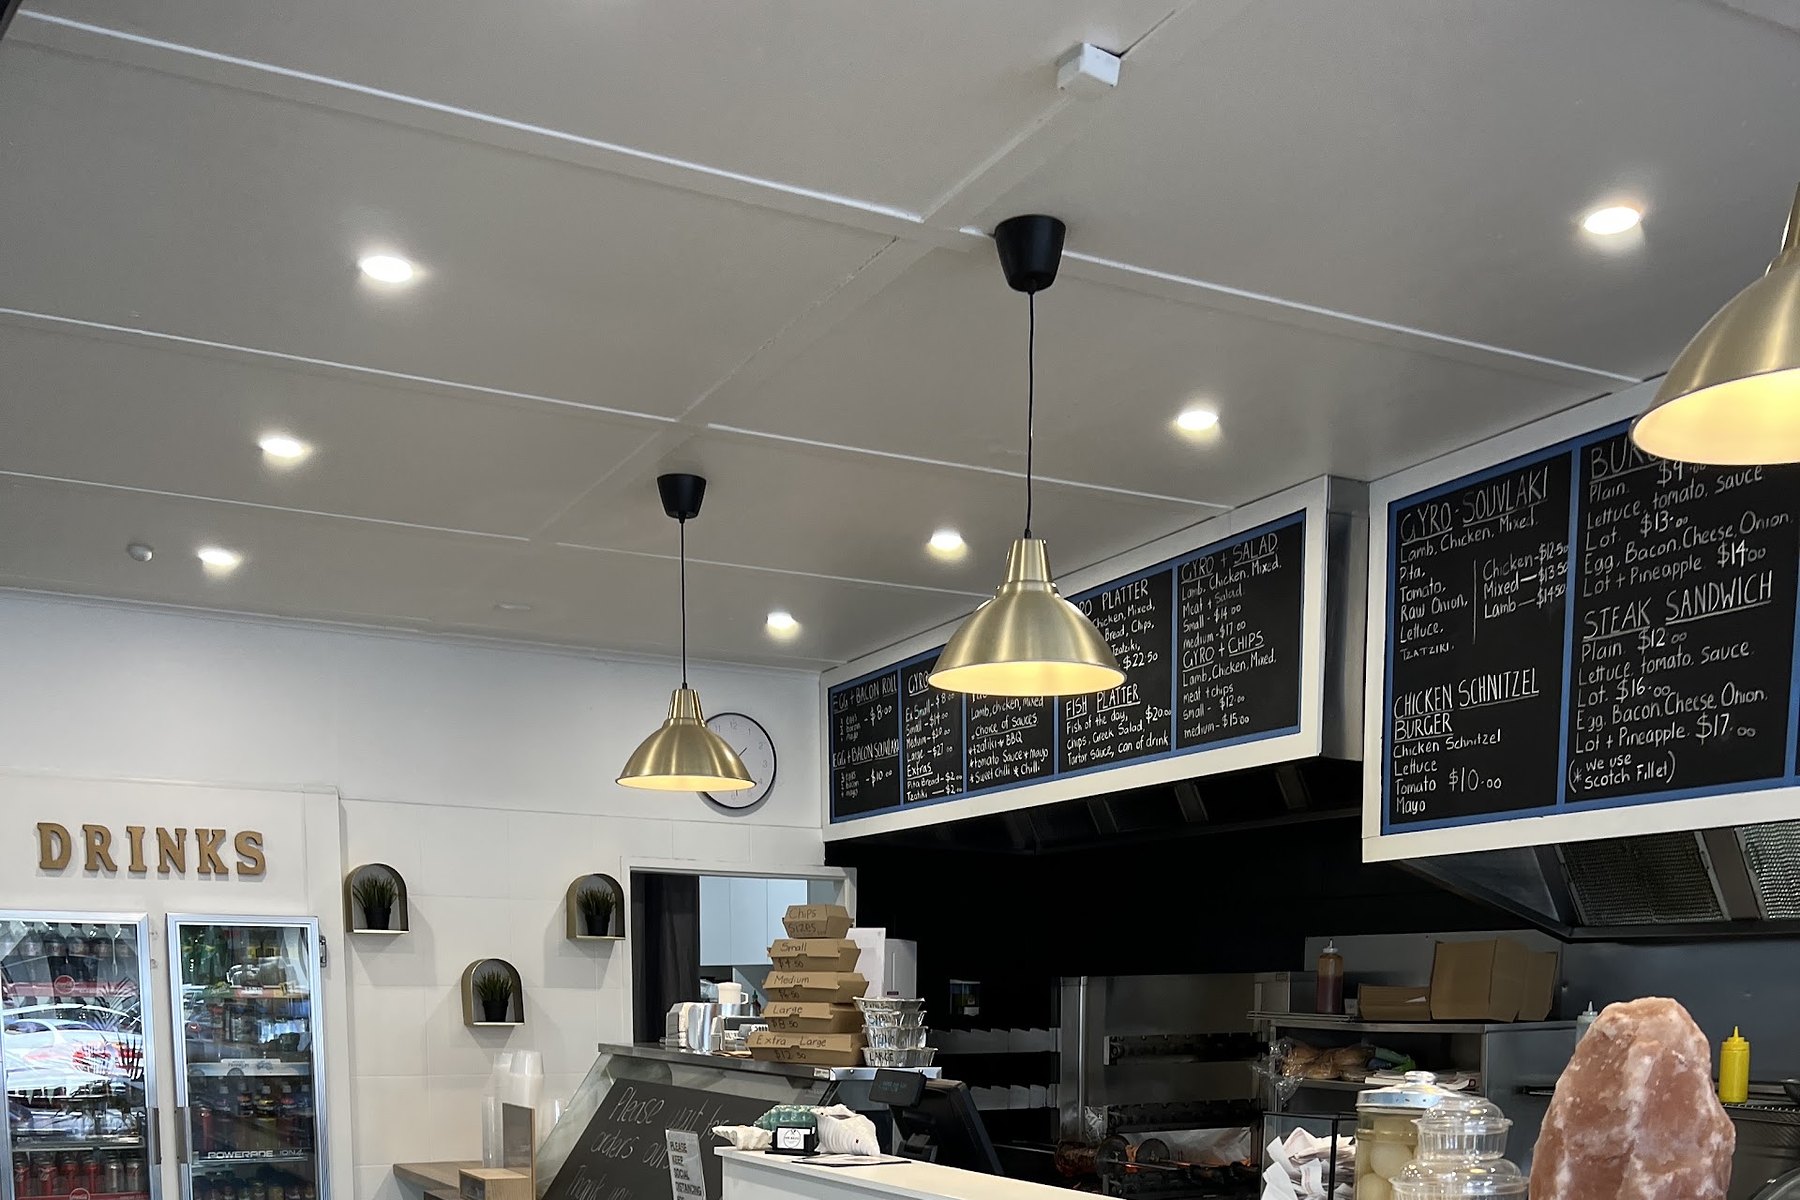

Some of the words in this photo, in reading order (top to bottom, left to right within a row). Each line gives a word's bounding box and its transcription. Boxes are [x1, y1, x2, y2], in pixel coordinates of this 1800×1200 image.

[1462, 466, 1548, 524] SOUVLAKI
[1182, 556, 1214, 582] GYRO
[1102, 579, 1149, 612] PLATTER
[1583, 575, 1610, 598] Lot
[1401, 603, 1425, 623] Raw
[1583, 597, 1650, 639] STEAK
[1666, 576, 1773, 622] SANDWICH
[1182, 646, 1214, 670] GYRO
[1228, 630, 1264, 653] CHIPS
[1066, 695, 1087, 718] FISH
[1097, 683, 1140, 712] PLATTER
[1394, 683, 1453, 719] CHICKEN
[1458, 667, 1540, 708] SCHNITZEL
[1001, 715, 1009, 729] of
[1066, 718, 1082, 735] Fish
[1084, 715, 1092, 729] of
[1095, 712, 1107, 727] the
[1394, 712, 1453, 742] BURGER
[1006, 731, 1022, 746] BBQ
[1092, 729, 1114, 744] Greek
[1118, 742, 1132, 753] can
[1136, 735, 1144, 750] of
[1145, 730, 1169, 747] drink
[1393, 741, 1440, 759] Chicken
[1445, 728, 1501, 750] Schnitzel
[1576, 732, 1600, 754] Lot
[907, 762, 931, 777] Extras
[1394, 759, 1438, 777] Lettuce
[1610, 753, 1632, 769] use
[1395, 775, 1437, 796] Tomato
[1448, 767, 1502, 793] $10.00
[1396, 796, 1426, 815] Mayo
[37, 822, 267, 875] DRINKS
[789, 908, 816, 919] Chips
[780, 942, 807, 952] Small
[774, 975, 810, 984] Medium
[773, 1005, 803, 1014] Large
[756, 1036, 787, 1046] Extra
[800, 1036, 826, 1047] Large
[609, 1086, 664, 1124] Please
[670, 1141, 687, 1153] PLEASE
[674, 1168, 690, 1180] SOCIAL
